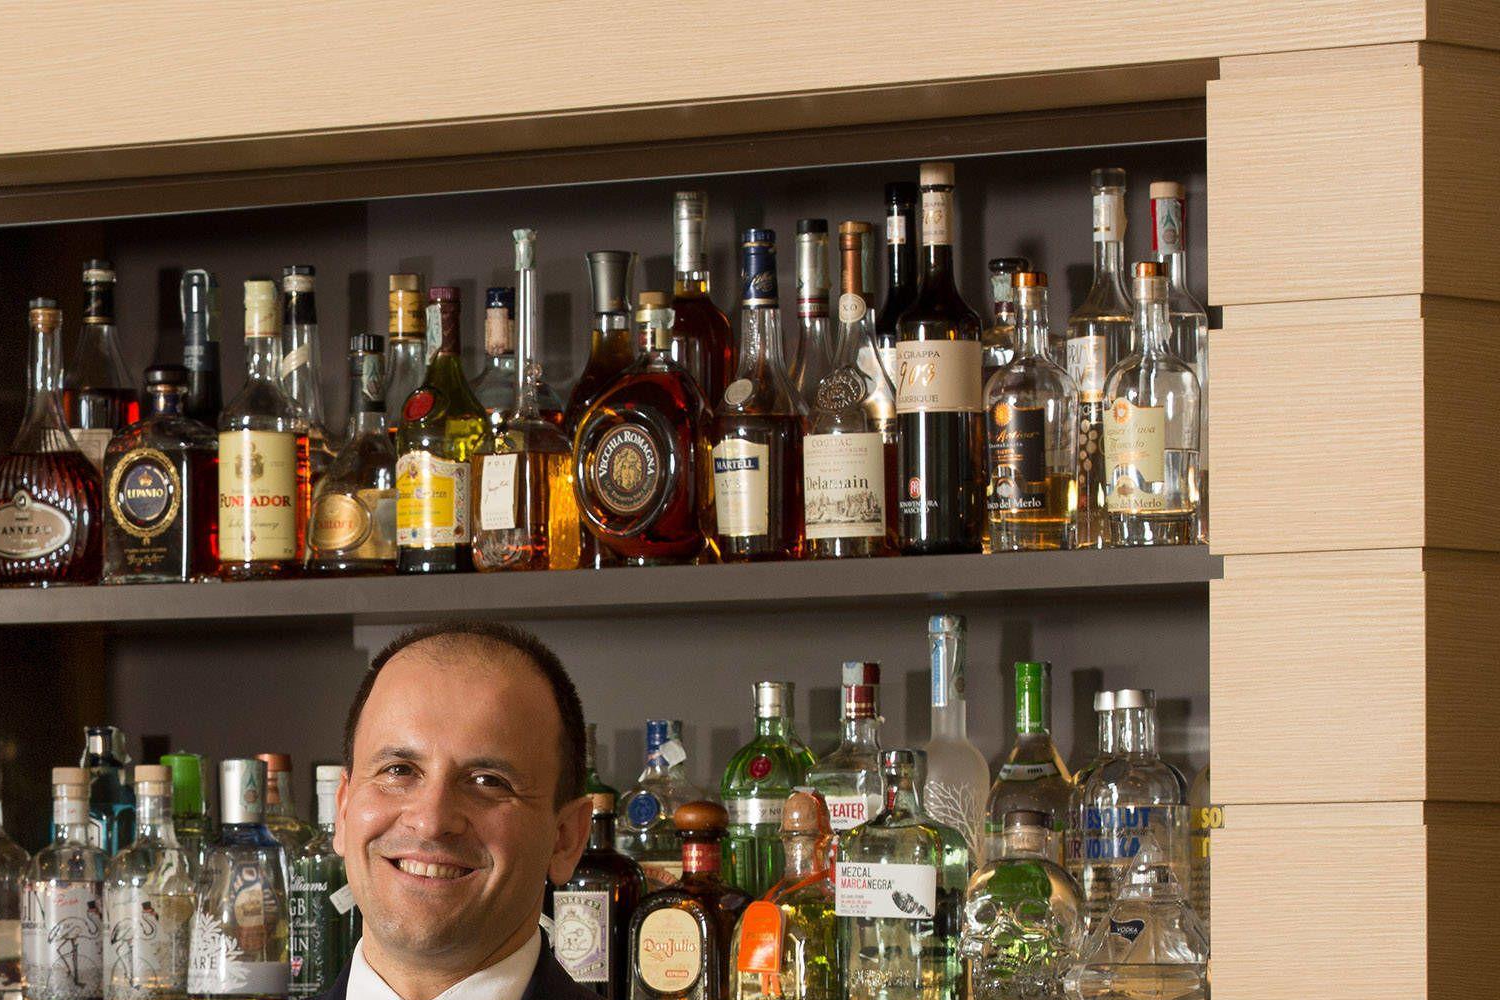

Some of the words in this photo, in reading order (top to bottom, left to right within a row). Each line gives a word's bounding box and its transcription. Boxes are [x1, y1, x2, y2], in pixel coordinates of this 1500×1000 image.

[905, 350, 941, 361] GRAPPA
[598, 434, 624, 478] VECCHIA
[623, 430, 656, 476] ROMAGNA
[715, 459, 755, 471] MARTELL
[805, 474, 869, 491] Delamain
[126, 488, 164, 499] LEPANTO
[999, 498, 1012, 510] del
[1014, 497, 1042, 509] Merlo
[840, 866, 872, 878] MEZCAL
[840, 879, 893, 890] MARCANEGRA
